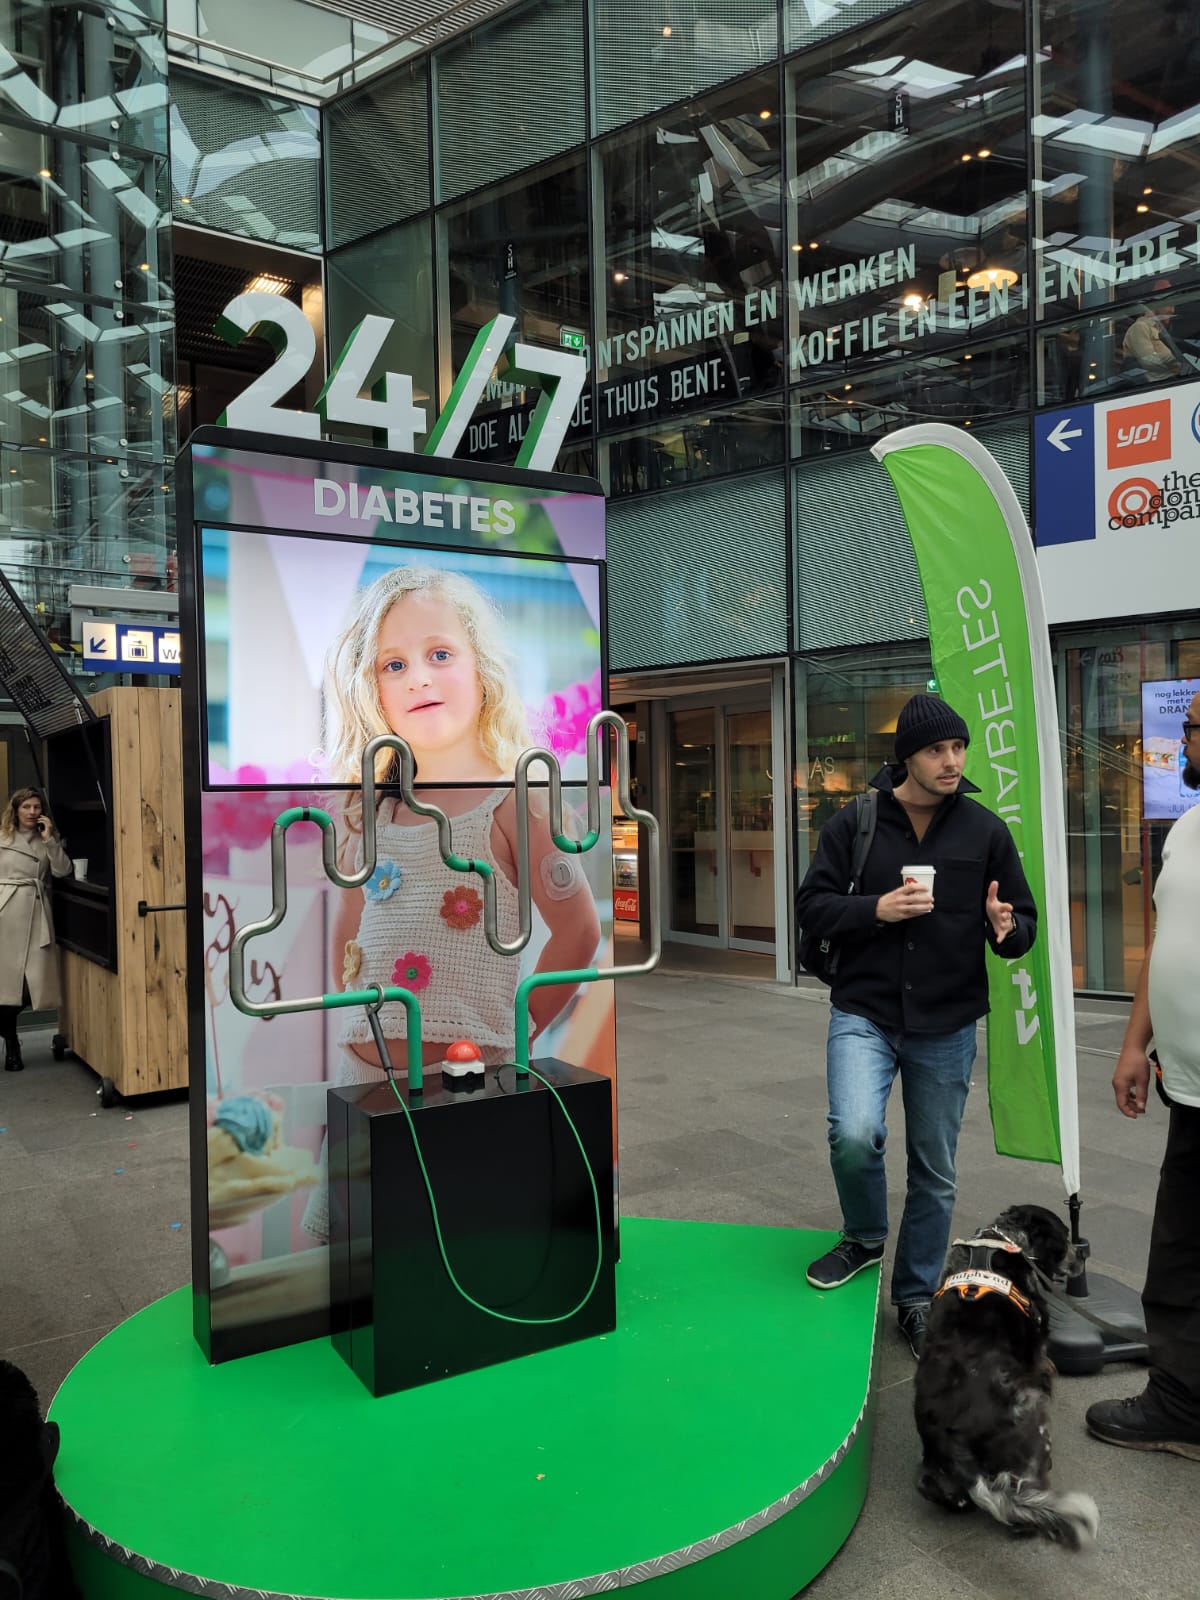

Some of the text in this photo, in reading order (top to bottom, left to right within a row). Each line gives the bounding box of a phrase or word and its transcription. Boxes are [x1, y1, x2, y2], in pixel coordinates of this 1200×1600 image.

[744, 286, 778, 328] EN
[792, 243, 916, 312] WERKEN
[790, 312, 889, 371] KOFFIE
[899, 298, 937, 342] EN
[949, 278, 1009, 329] EEN
[220, 291, 587, 473] 24/7
[468, 419, 499, 454] DOE
[570, 394, 593, 428] JE
[603, 375, 659, 419] THUIS
[670, 357, 726, 402] BENT:
[313, 478, 516, 535] DIABETES
[1162, 470, 1200, 492] the
[162, 647, 181, 661] W
[1154, 691, 1171, 700] nog
